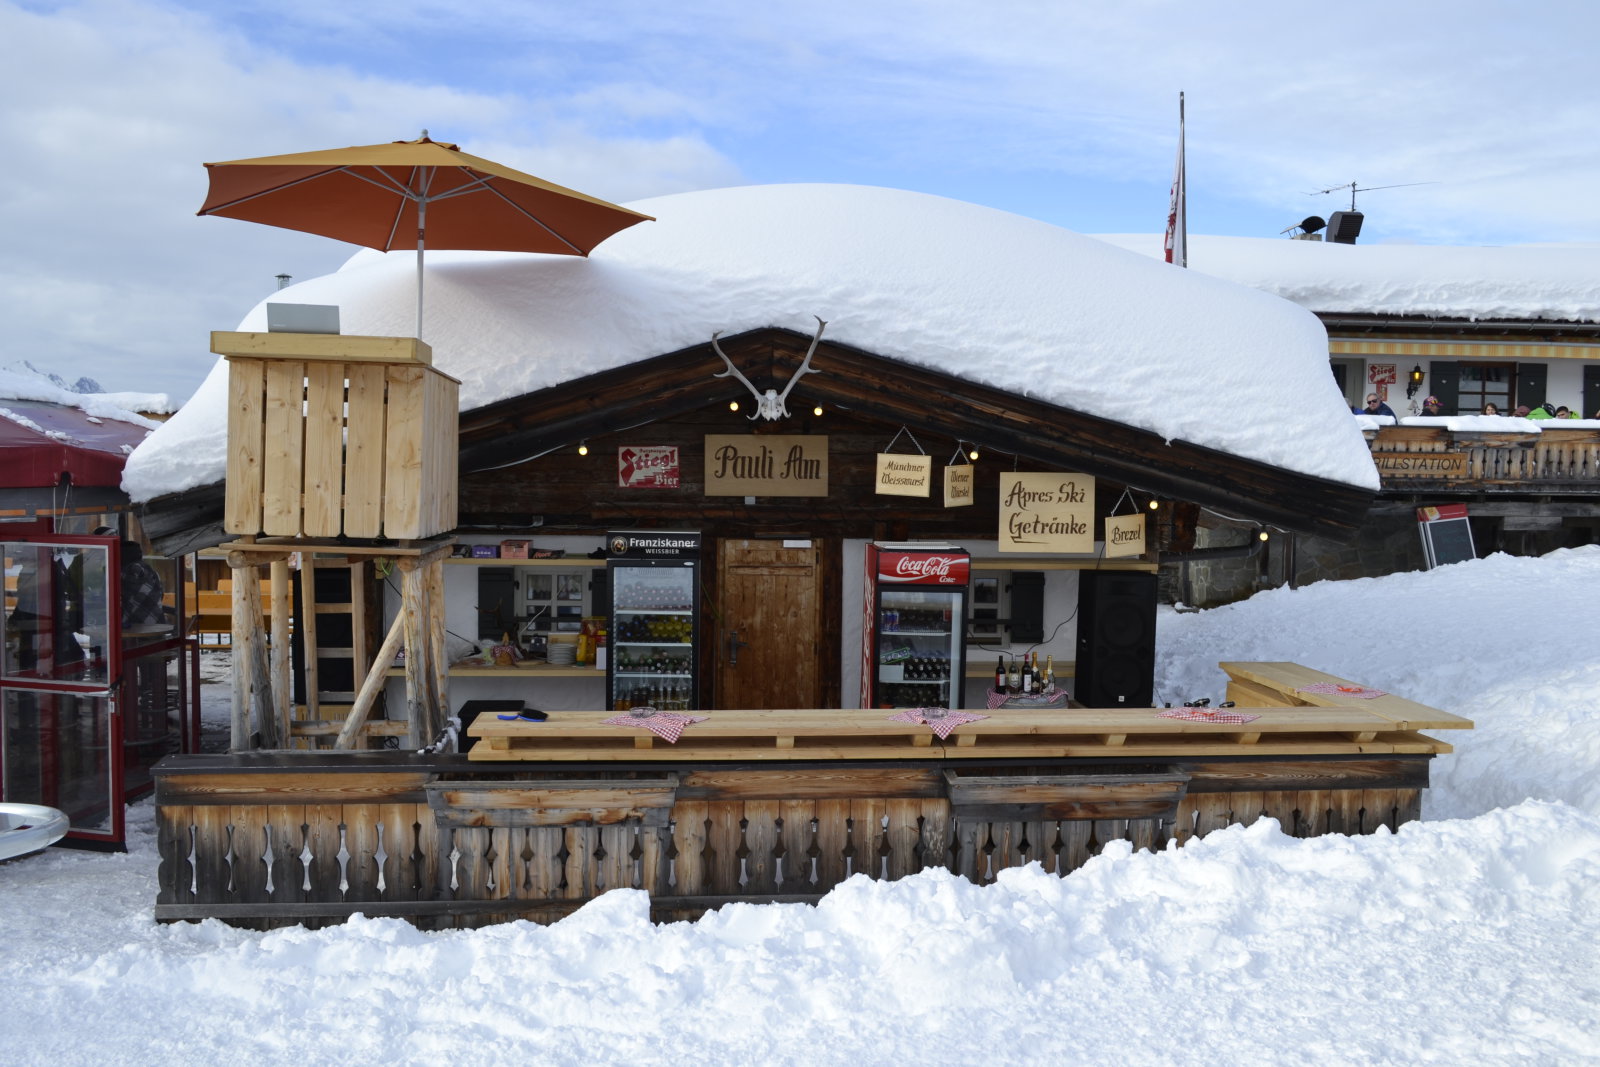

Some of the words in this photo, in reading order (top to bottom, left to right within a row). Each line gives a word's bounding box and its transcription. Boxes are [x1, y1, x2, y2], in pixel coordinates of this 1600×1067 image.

[620, 448, 676, 486] Stiegl
[714, 444, 774, 479] Pauli
[885, 460, 925, 472] Münchner
[1374, 457, 1462, 471] RILLSTATION
[655, 474, 679, 485] Bier
[881, 472, 925, 486] Weisswurst
[1057, 481, 1086, 504] Ski
[1008, 512, 1087, 544] Getränke
[1111, 523, 1142, 545] Brezel
[629, 537, 696, 548] Franziskaner
[896, 556, 951, 576] Coca-Cola
